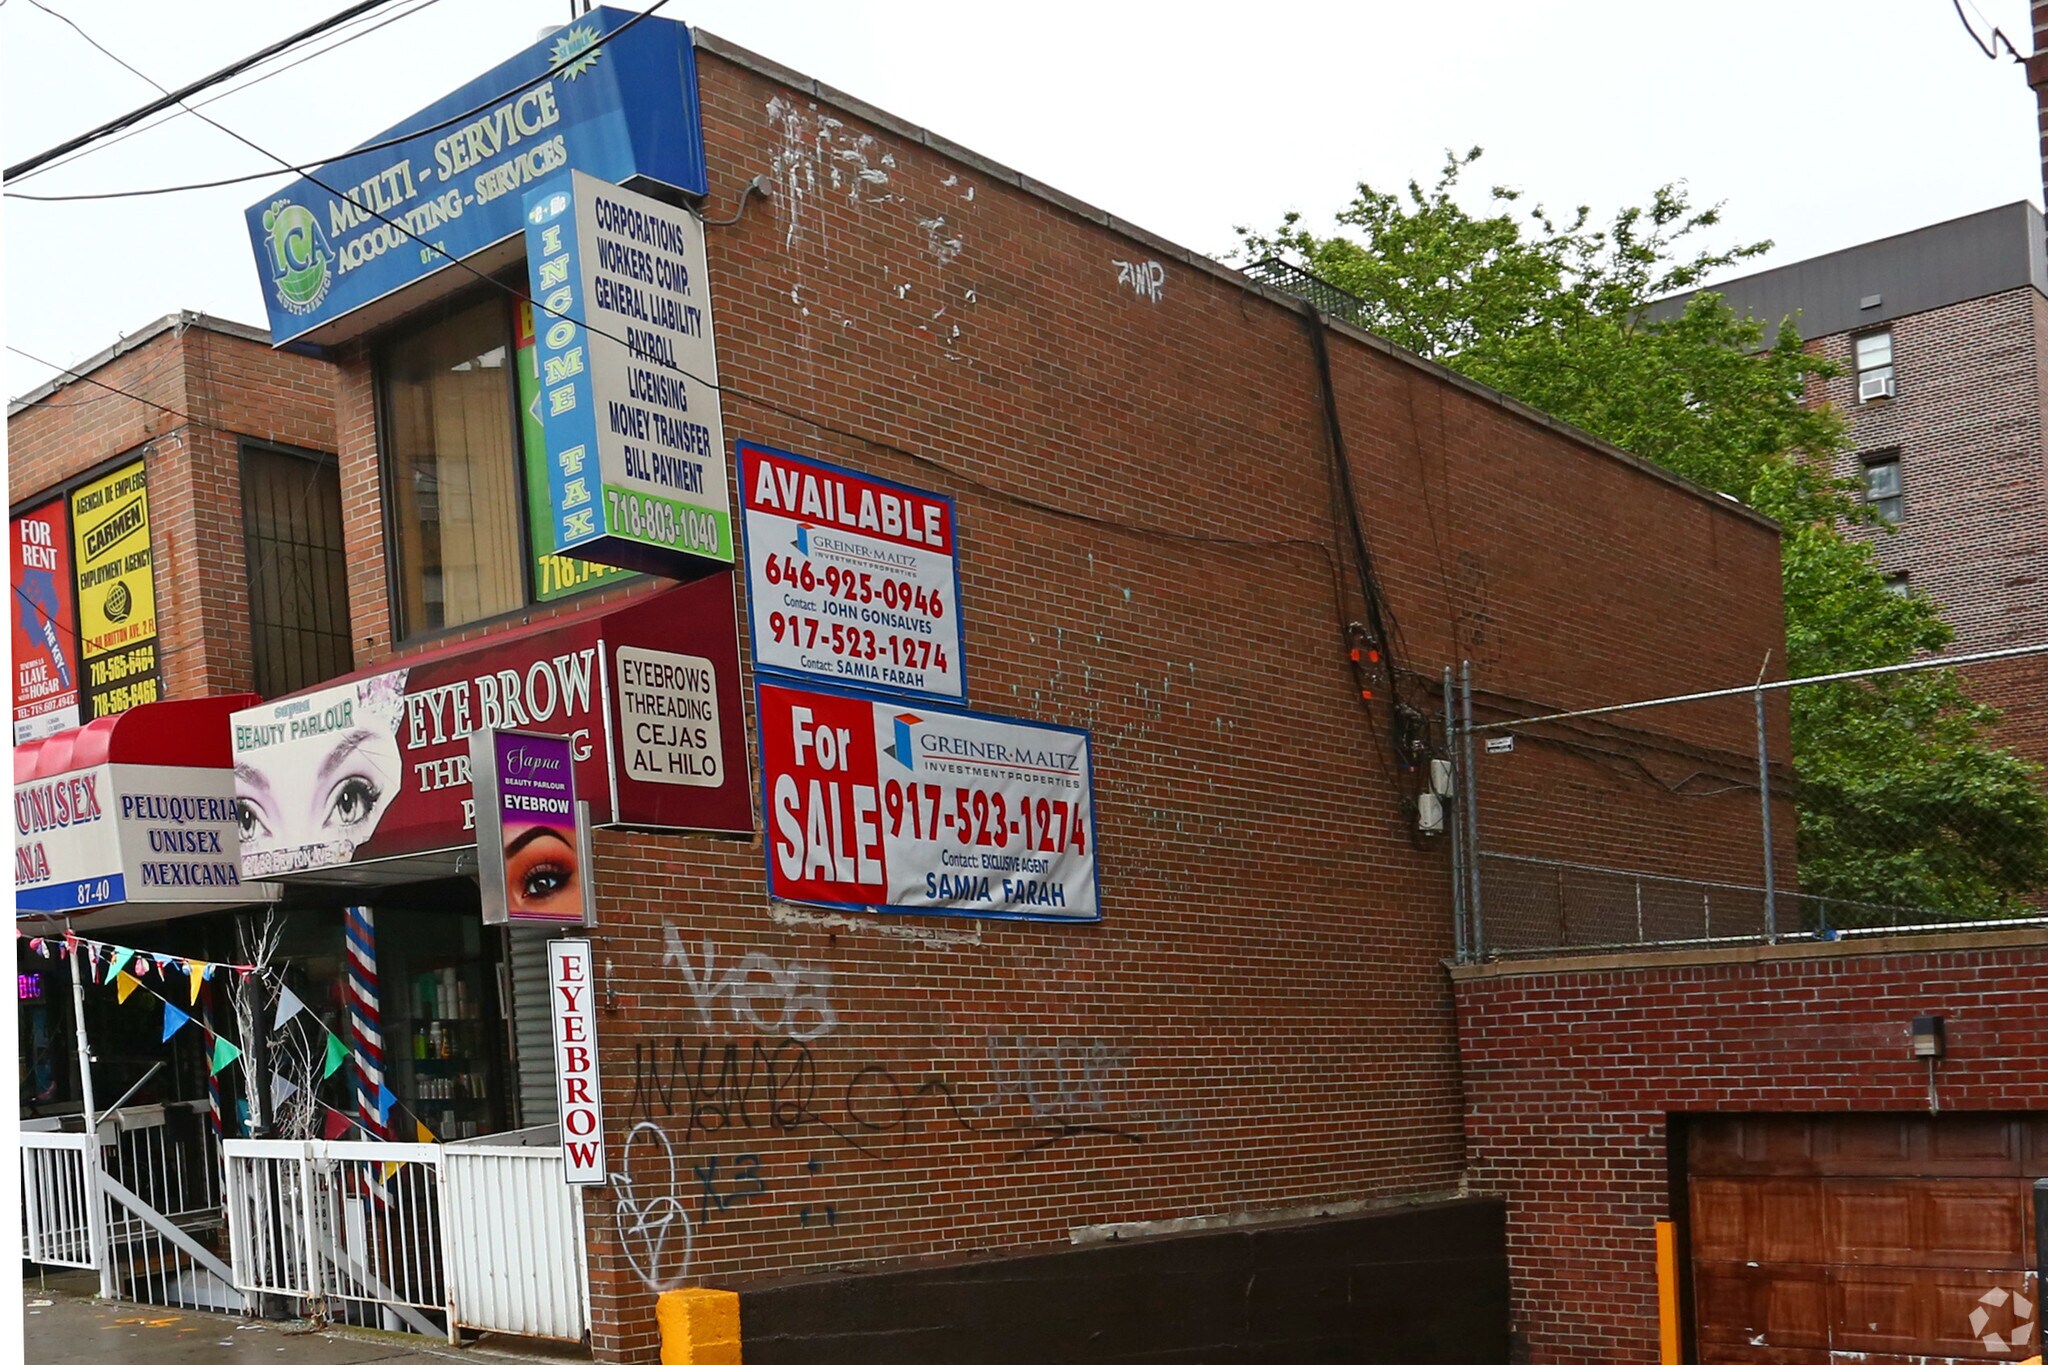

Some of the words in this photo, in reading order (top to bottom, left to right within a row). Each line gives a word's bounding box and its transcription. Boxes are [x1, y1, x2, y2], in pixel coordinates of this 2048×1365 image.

[328, 159, 417, 238] MULTI
[434, 82, 560, 181] SERVICE
[595, 197, 685, 256] CORPORATIONS
[264, 221, 335, 282] ICA
[596, 237, 653, 285] WORKERS
[655, 257, 691, 297] COMP.
[540, 224, 584, 417] INCOME
[595, 276, 648, 321] GENERAL
[650, 294, 701, 338] LIABILITY
[627, 326, 677, 369] PAYROLL
[627, 366, 688, 412] LICENSING
[609, 401, 650, 440] MONEY
[653, 414, 711, 458] TRANSFER
[558, 444, 594, 542] TAX
[624, 445, 650, 482] BILL
[653, 456, 703, 495] PAYMENT
[608, 491, 718, 555] 718-803-1040
[755, 460, 943, 547] AVAILABLE
[21, 519, 52, 546] FOR
[87, 504, 141, 556] CARMEN
[22, 544, 57, 570] RENT
[80, 558, 122, 590] EMPLOYMENT
[124, 548, 151, 574] AGENCY
[765, 552, 943, 619] 646-925-0946
[822, 600, 858, 620] JOHN
[861, 608, 932, 635] GONSALVES
[43, 620, 56, 648] THE
[51, 644, 65, 669] KEY
[769, 611, 947, 673] 917-523-1274
[20, 664, 48, 687] LLAVE
[30, 677, 60, 699] HOGAR
[623, 659, 710, 694] EYEBROWS
[837, 659, 879, 680] SAMIA
[883, 668, 924, 687] FARAH
[235, 723, 286, 753] BEAUTY
[290, 698, 354, 741] PARLOUR
[624, 691, 712, 722] THREADING
[636, 722, 707, 750] CEJAS
[791, 705, 850, 772] For
[505, 777, 532, 787] BEAUTY
[533, 780, 565, 790] PARLOUR
[507, 745, 561, 779] Sapna
[633, 749, 662, 773] AL
[669, 752, 716, 778] HILO
[14, 775, 101, 835] UNISEX
[121, 793, 238, 823] PELUQUERIA
[504, 794, 569, 814] EYEBROW
[885, 778, 1085, 856] 917-523-1274
[148, 829, 223, 856] UNISEX
[774, 773, 883, 885] SALE
[141, 861, 241, 887] MEXICANA
[941, 848, 979, 869] Contact:
[982, 853, 1020, 872] EXCLUSIVE
[1021, 857, 1049, 874] AGENT
[77, 879, 110, 904] 87-40
[926, 872, 992, 902] SAMIA
[1003, 878, 1066, 907] FARAH
[556, 955, 600, 1169] EYEBROW
